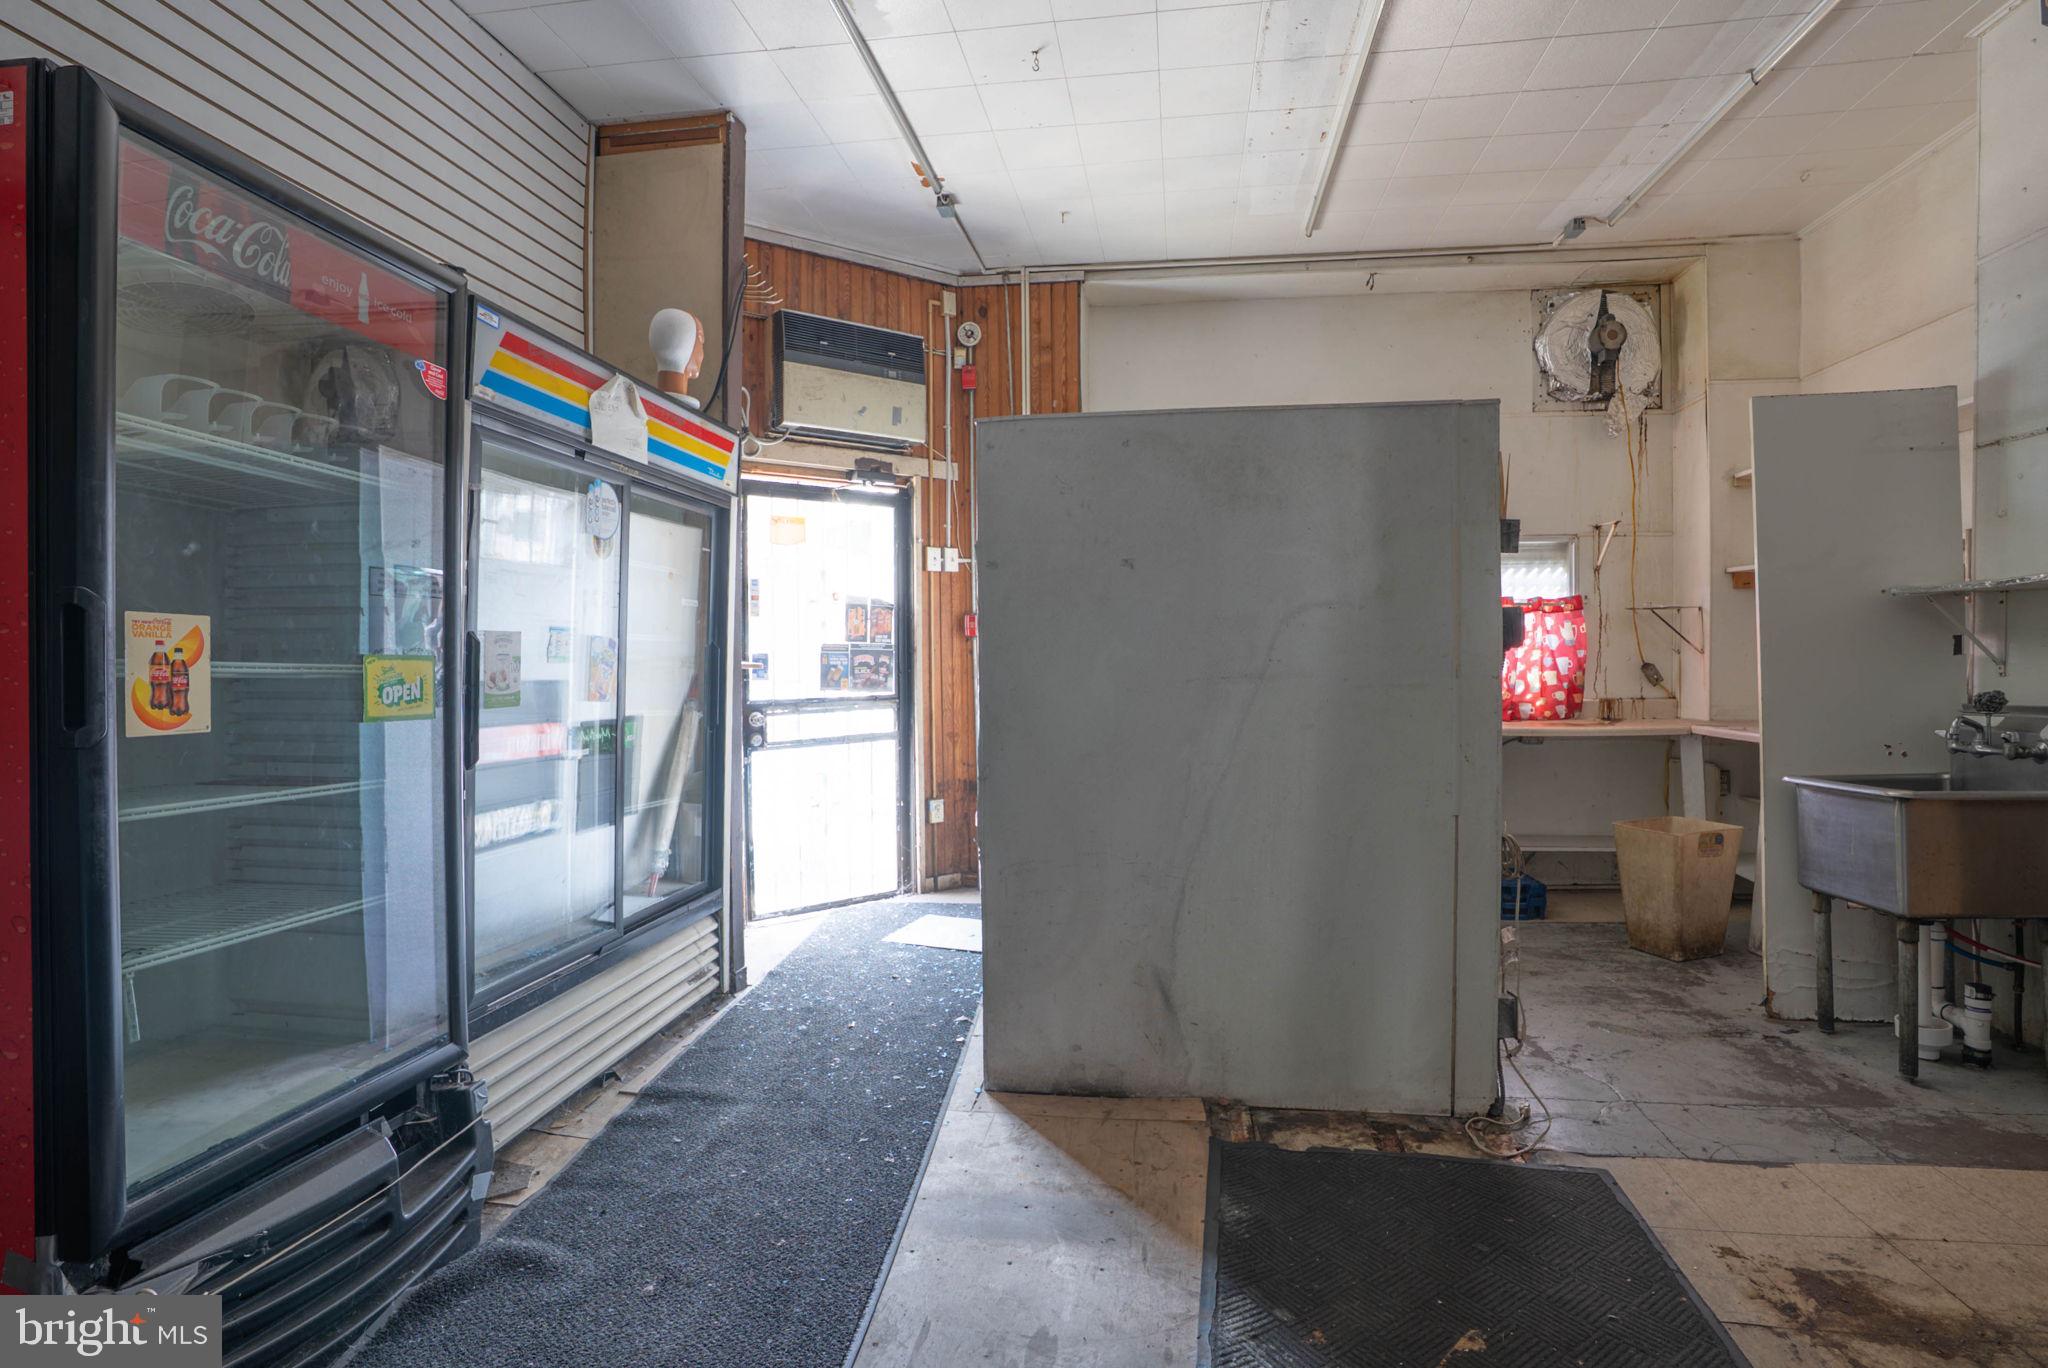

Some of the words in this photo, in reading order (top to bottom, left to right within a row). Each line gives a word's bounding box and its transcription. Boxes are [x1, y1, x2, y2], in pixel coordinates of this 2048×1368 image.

[165, 186, 290, 287] Coca-Cola
[321, 275, 354, 297] enjoy
[382, 676, 421, 704] OPEN
